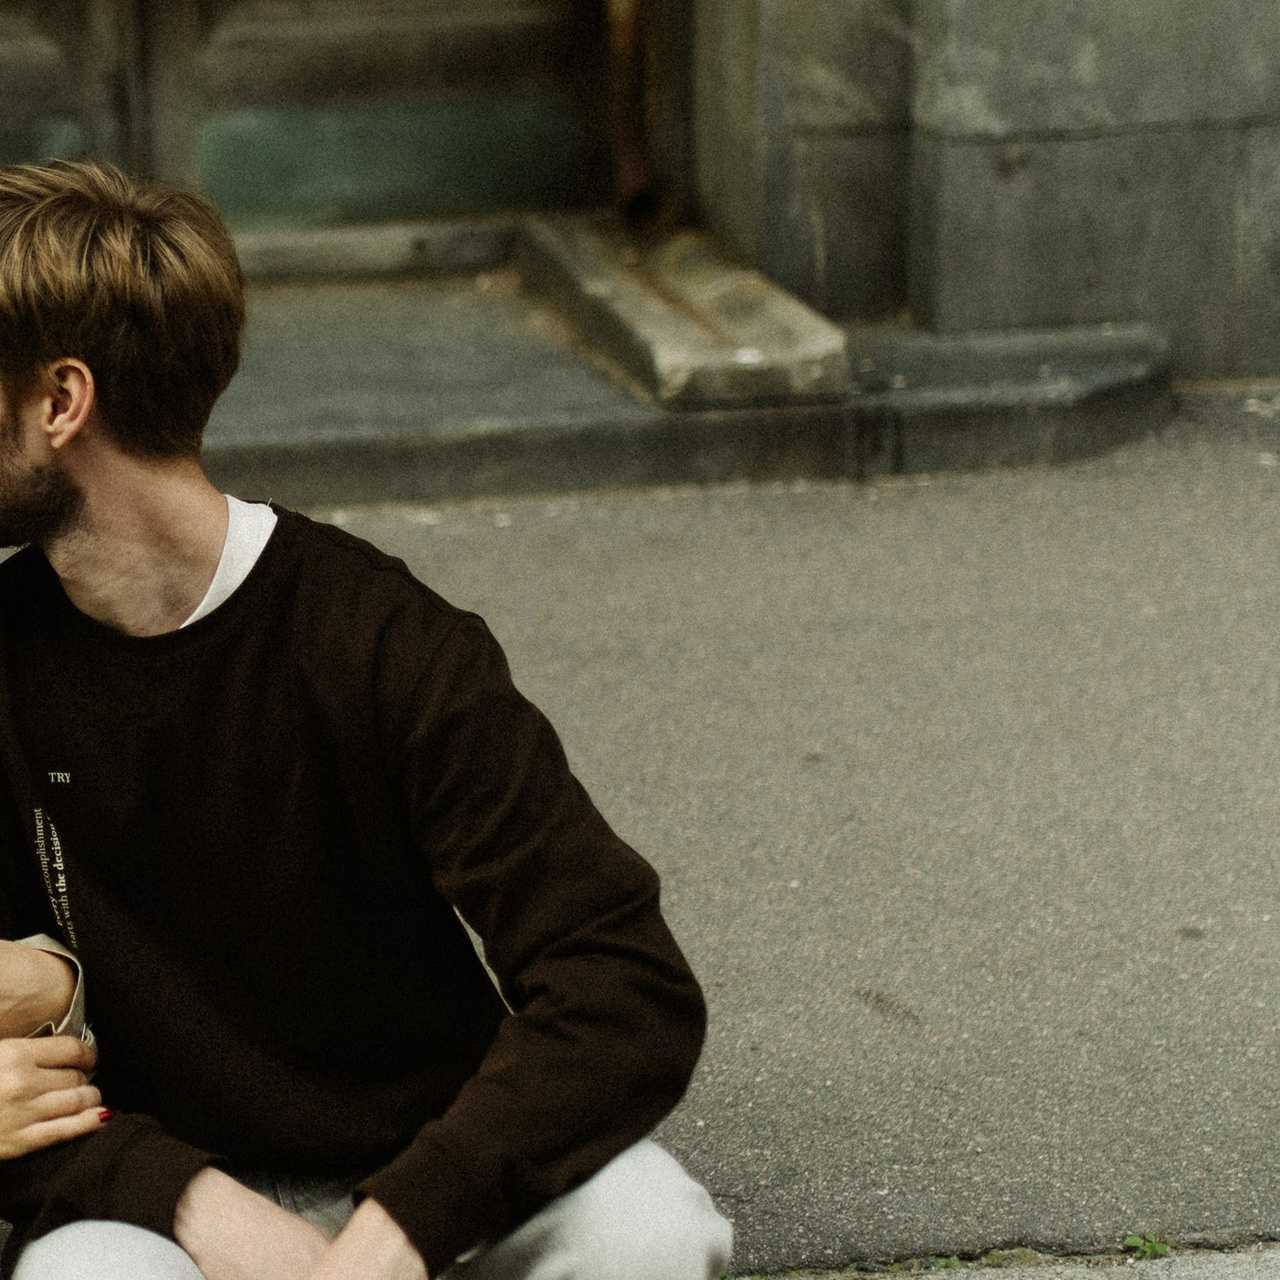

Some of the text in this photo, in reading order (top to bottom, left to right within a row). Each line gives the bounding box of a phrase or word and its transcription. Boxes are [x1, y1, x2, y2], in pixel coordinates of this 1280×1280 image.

[48, 772, 71, 783] TRY
[33, 807, 53, 895] accomplishment
[50, 823, 78, 949] starts with the decision
